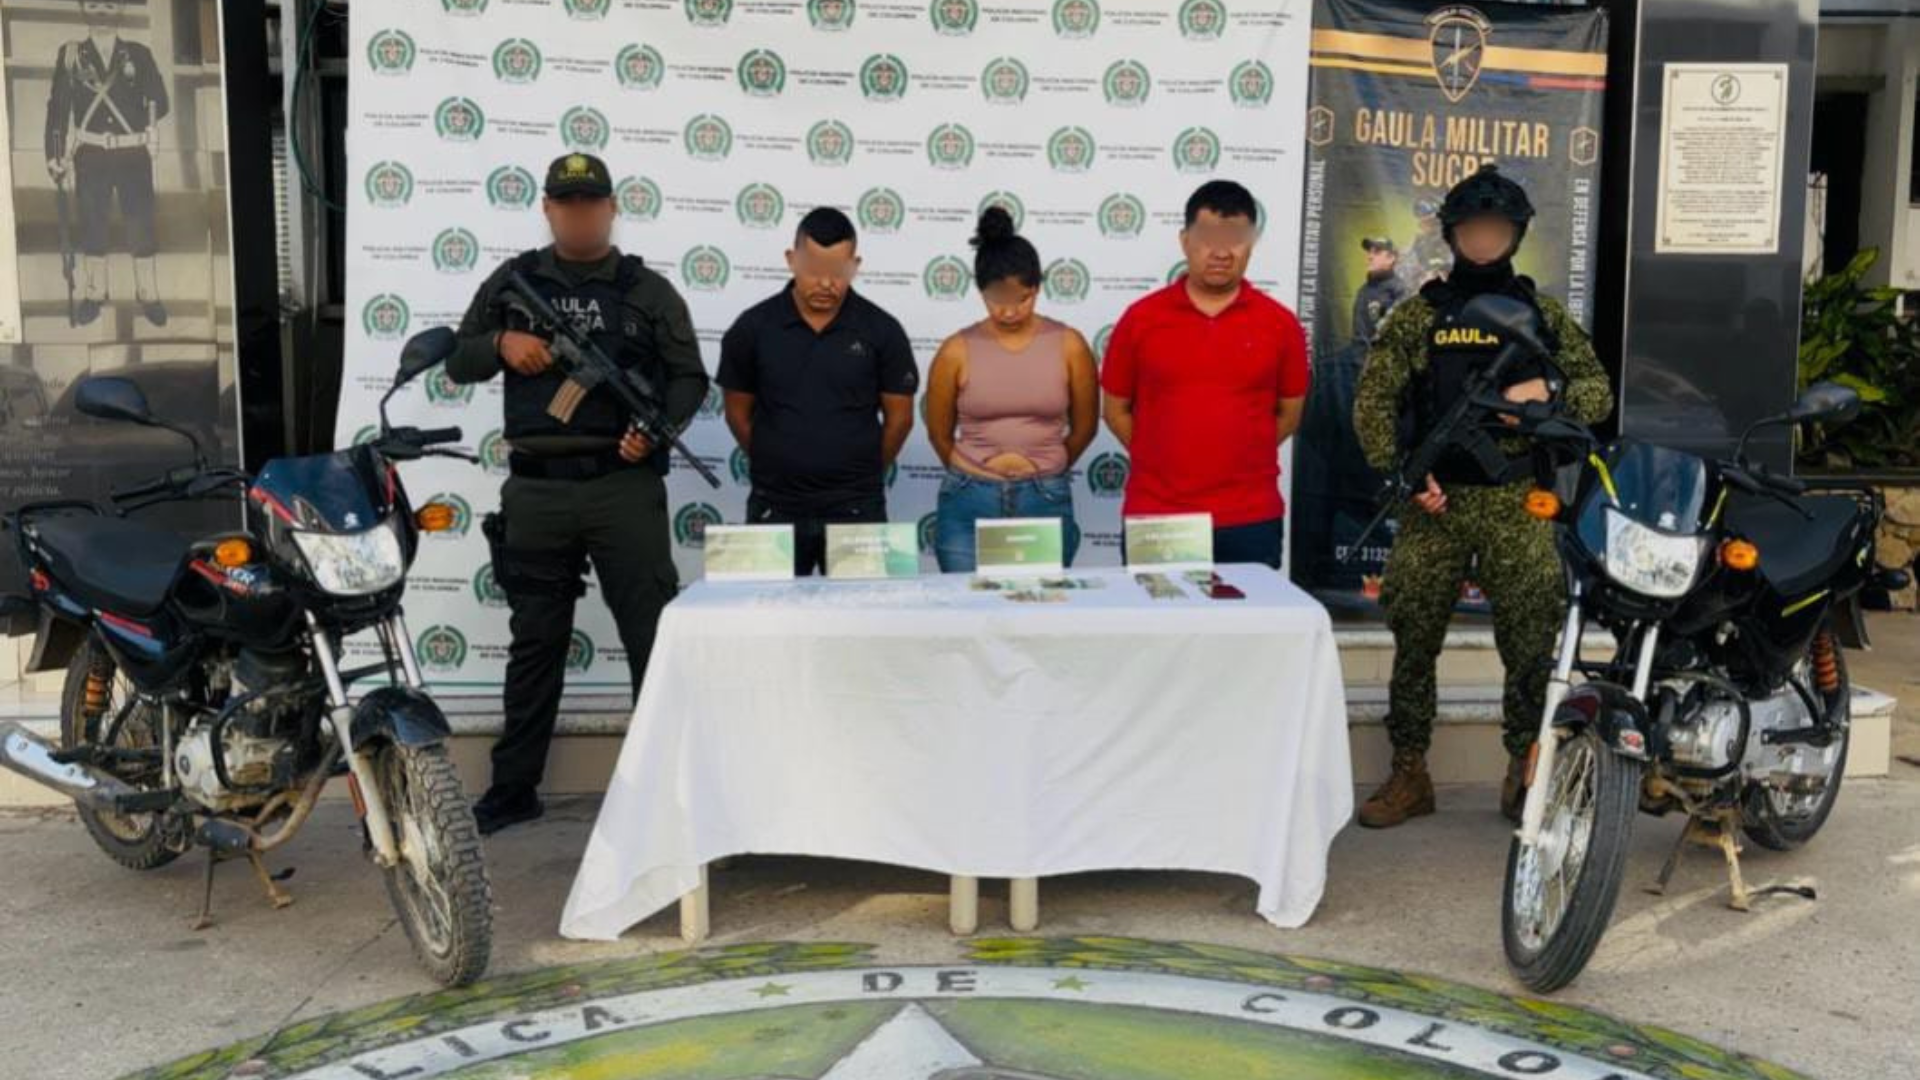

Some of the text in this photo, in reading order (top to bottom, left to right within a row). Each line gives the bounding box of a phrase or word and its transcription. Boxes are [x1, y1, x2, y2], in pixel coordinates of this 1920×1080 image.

[1355, 108, 1550, 157] GAULA MILITAR
[1412, 151, 1495, 188] SUCR
[862, 970, 979, 993] DE
